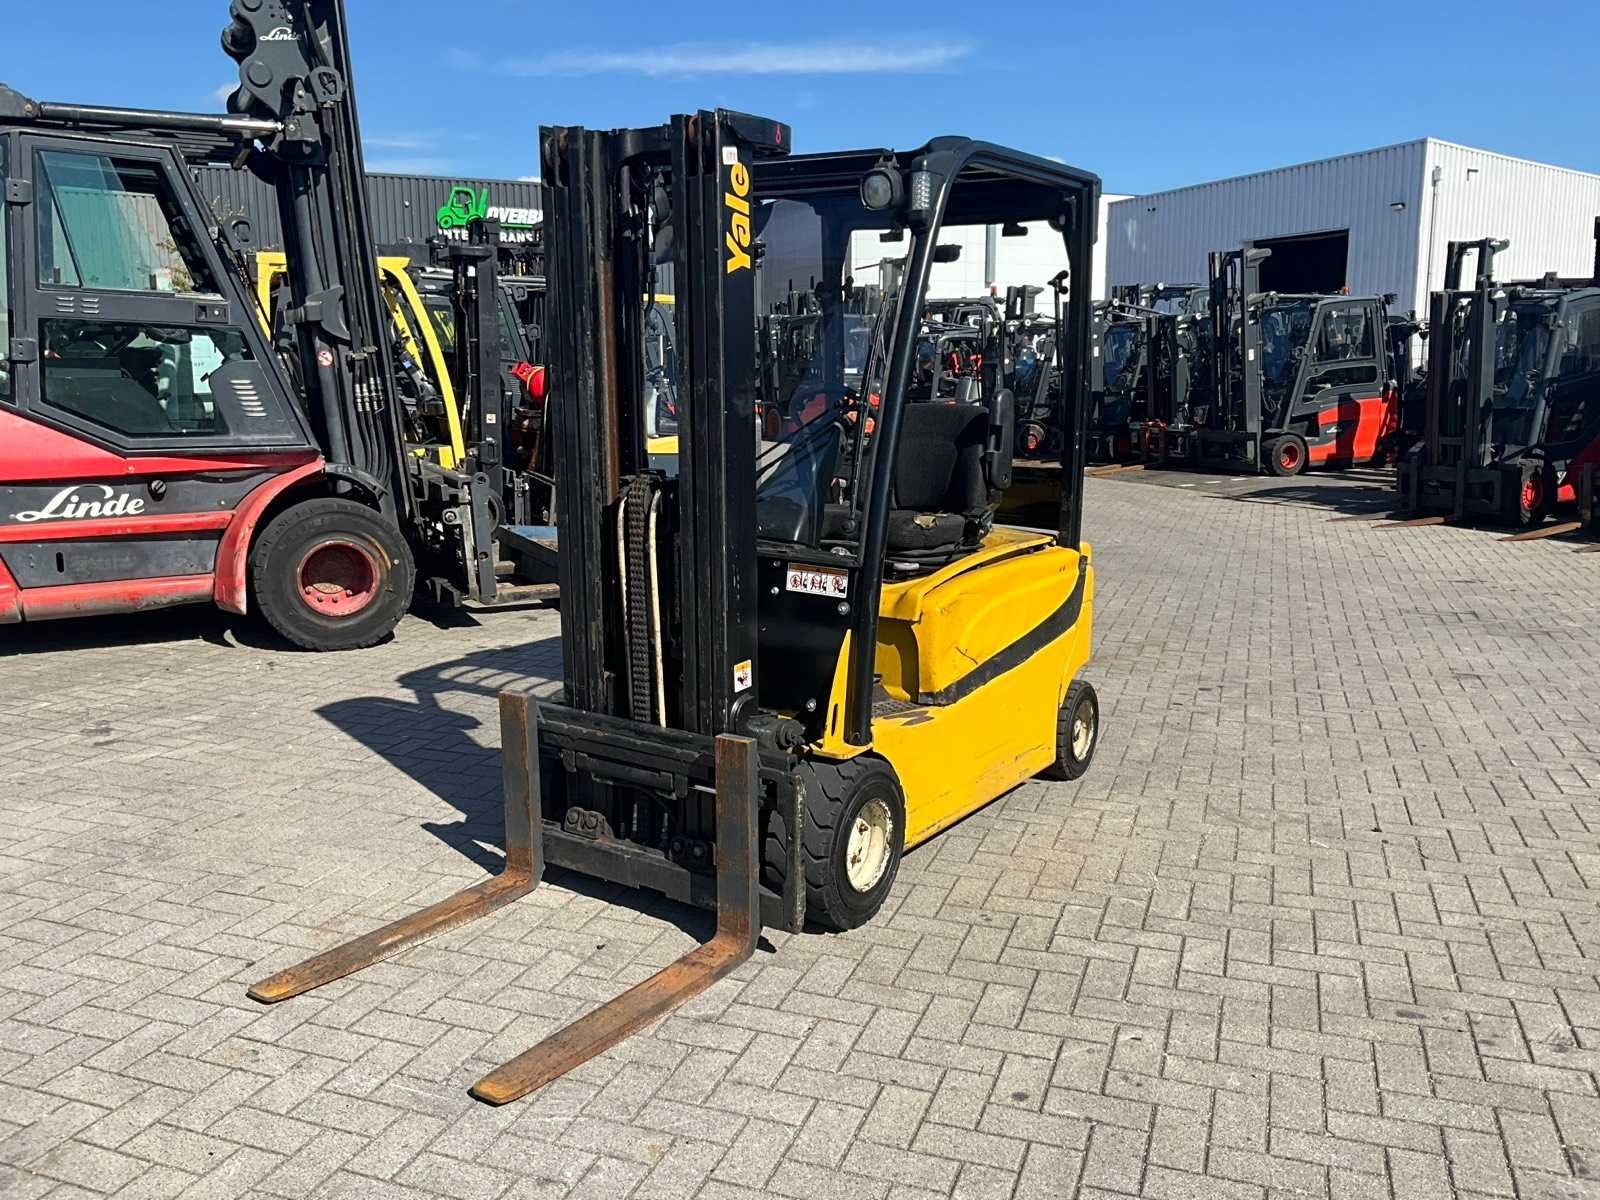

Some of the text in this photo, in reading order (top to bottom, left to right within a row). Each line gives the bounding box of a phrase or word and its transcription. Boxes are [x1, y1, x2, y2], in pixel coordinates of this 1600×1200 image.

[486, 206, 544, 225] OVERB
[725, 161, 751, 274] Yale
[15, 483, 145, 522] Linde
